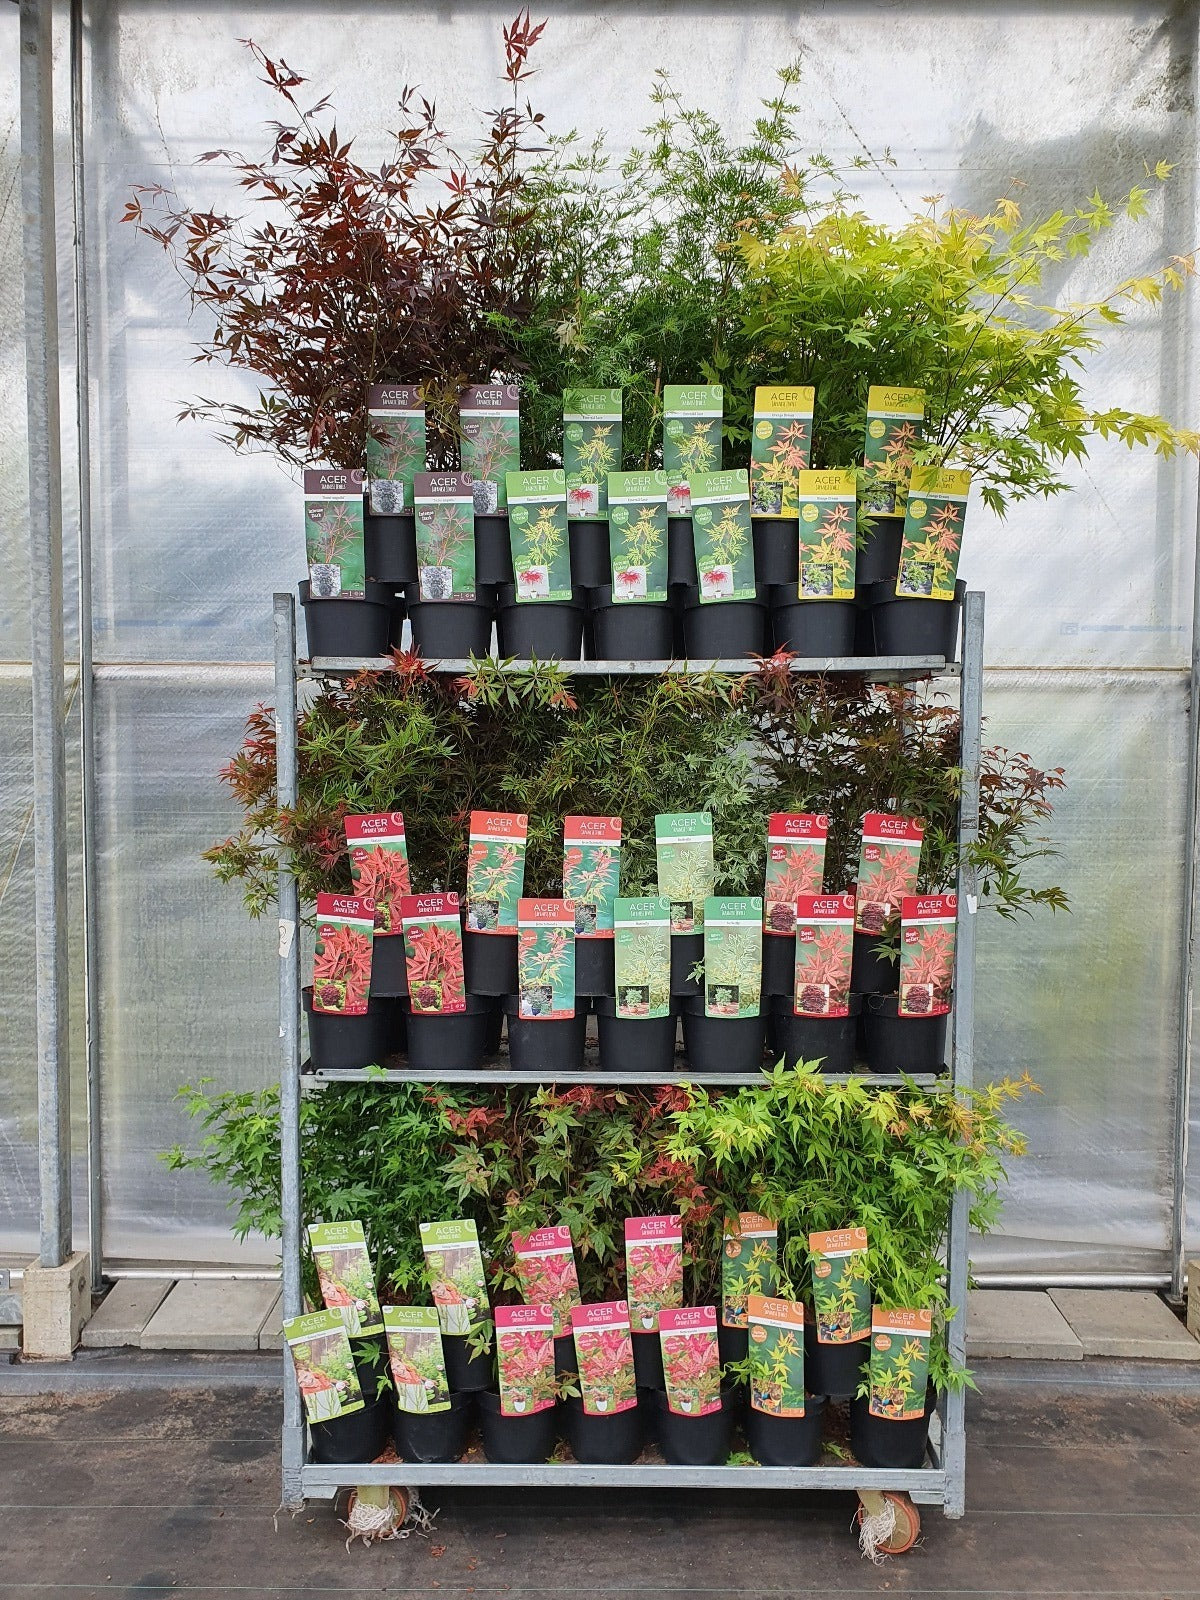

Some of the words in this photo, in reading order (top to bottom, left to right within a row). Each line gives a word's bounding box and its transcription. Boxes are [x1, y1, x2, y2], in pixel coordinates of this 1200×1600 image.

[381, 390, 409, 399] ACER
[475, 390, 503, 399] ACER
[680, 391, 707, 400] ACER
[771, 392, 798, 401] ACER
[320, 475, 347, 484] ACER
[430, 477, 457, 486] ACER
[522, 476, 550, 486] ACER
[624, 476, 651, 486] ACER
[705, 475, 733, 487] ACER
[815, 476, 841, 484] ACER
[360, 818, 388, 828] ACER
[486, 818, 512, 826] ACER
[670, 818, 697, 827] ACER
[785, 820, 812, 828] ACER
[880, 820, 908, 829] ACER
[333, 899, 359, 909] ACER
[416, 898, 443, 908] ACER
[629, 902, 655, 911] ACER
[917, 900, 942, 909] ACER
[435, 1225, 461, 1235] ACER
[640, 1221, 666, 1230] ACER
[323, 1226, 349, 1236] ACER
[528, 1232, 555, 1243] ACER
[825, 1233, 851, 1244] ACER
[763, 1302, 788, 1312] ACER
[511, 1309, 537, 1318] ACER
[586, 1307, 613, 1317] ACER
[674, 1312, 700, 1321] ACER
[888, 1312, 915, 1320] ACER
[299, 1315, 327, 1328] ACER
